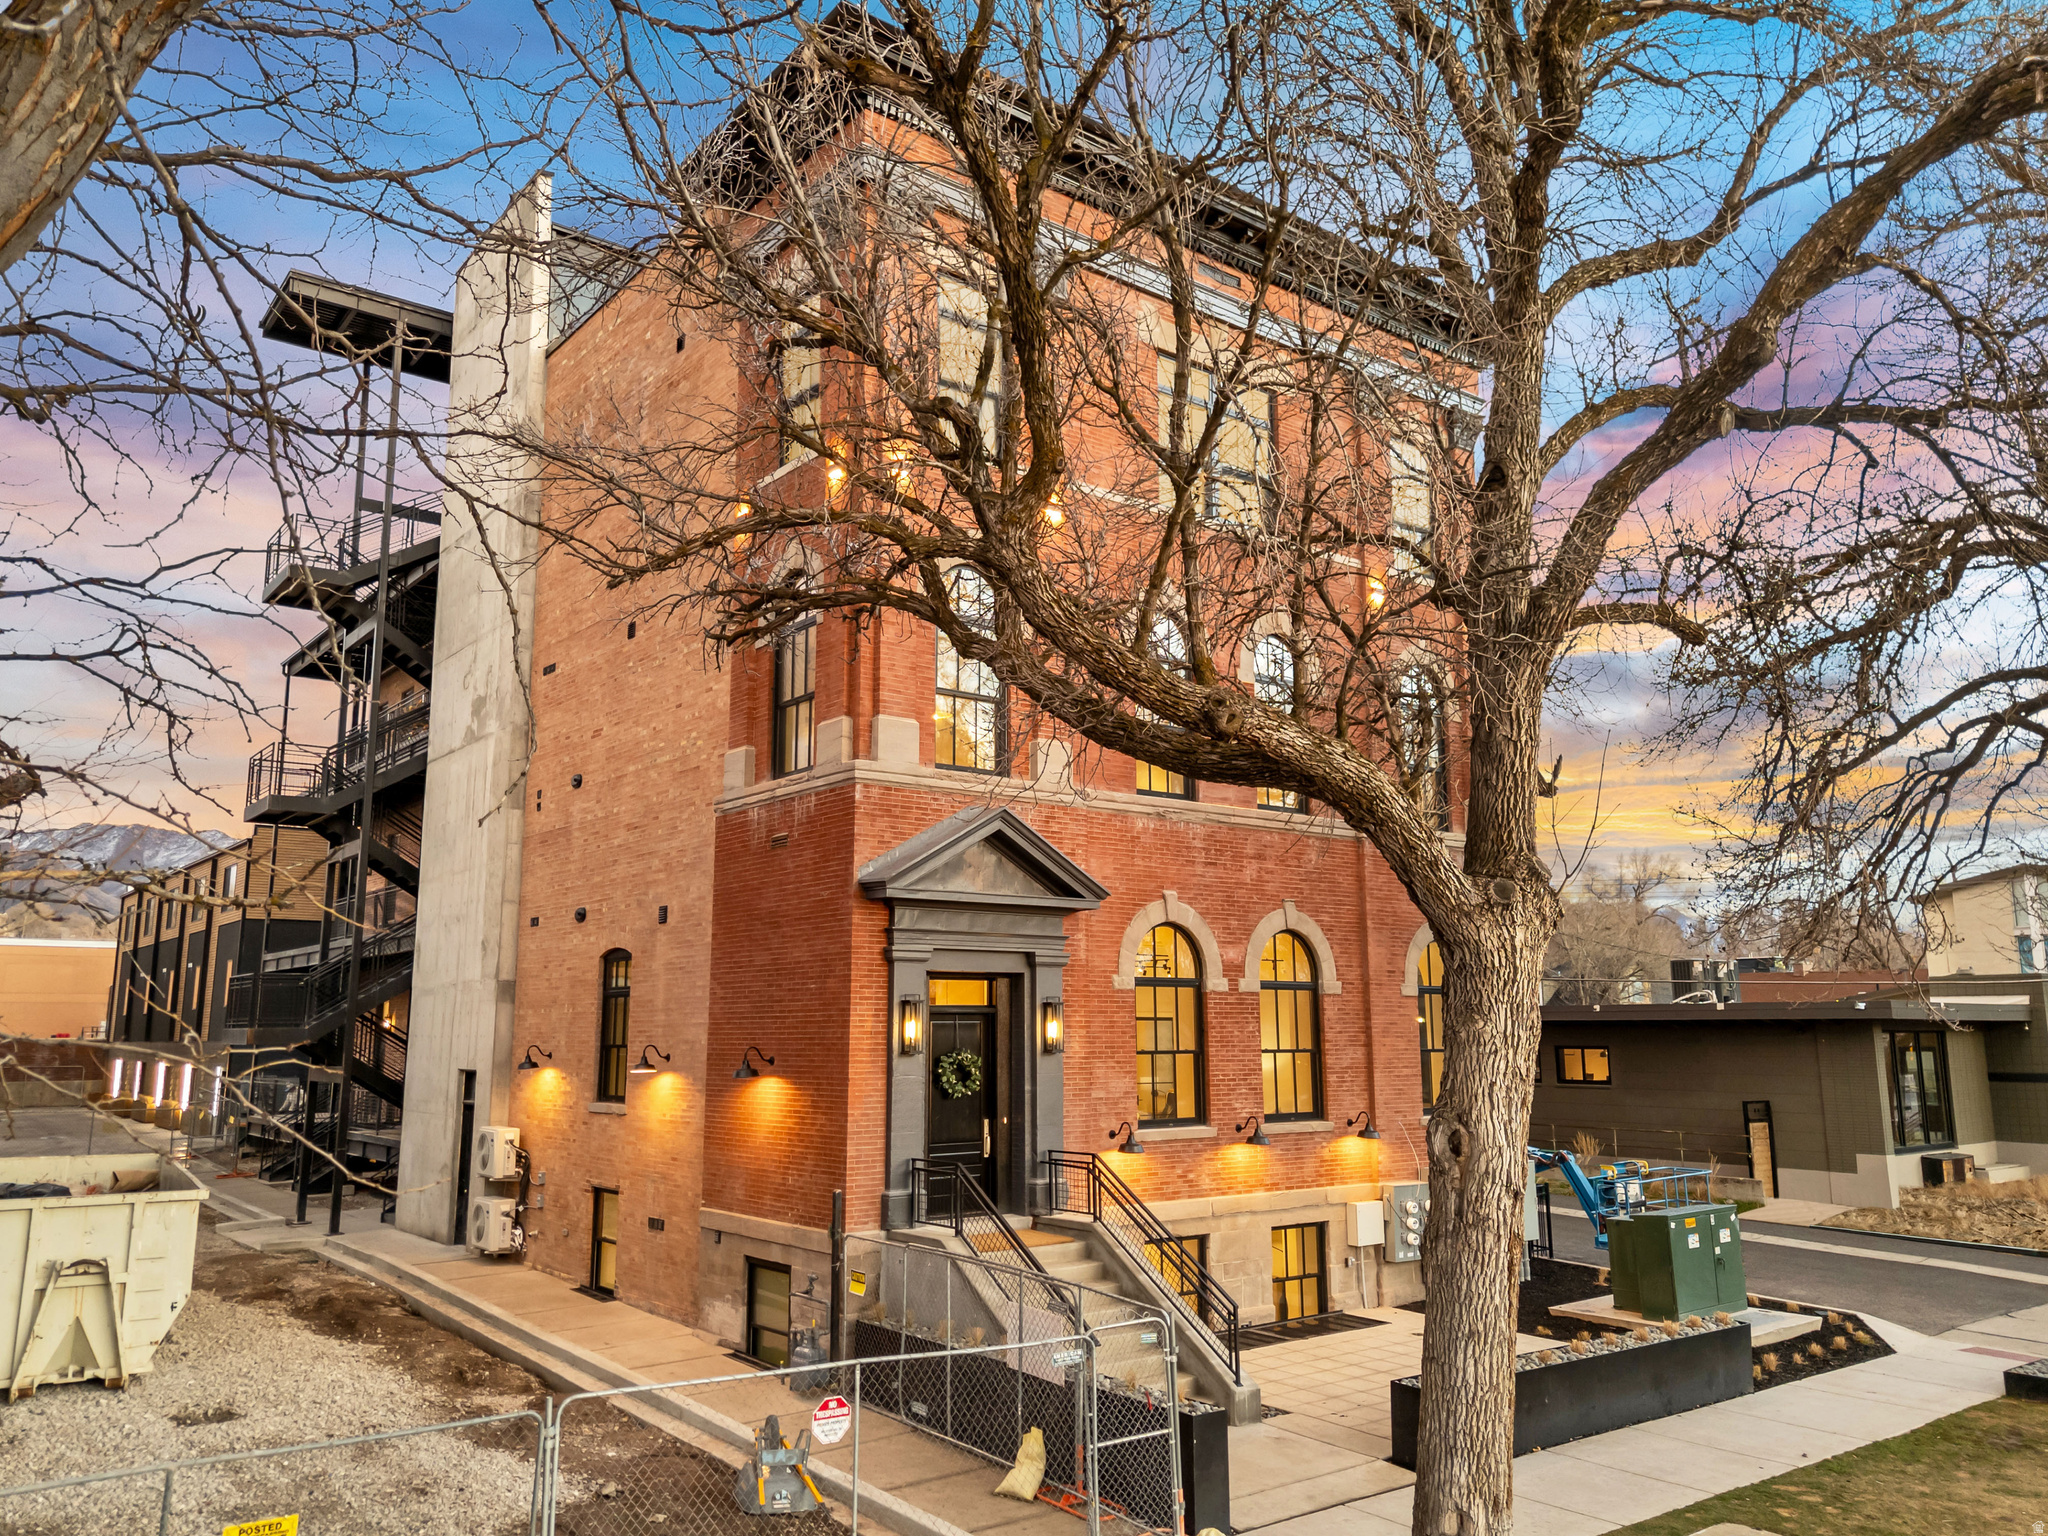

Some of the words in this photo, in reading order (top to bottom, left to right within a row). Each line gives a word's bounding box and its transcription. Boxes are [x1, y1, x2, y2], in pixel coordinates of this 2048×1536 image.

[828, 1400, 837, 1408] NO
[816, 1407, 849, 1419] TRESPASSING
[239, 1522, 283, 1536] POSTED
